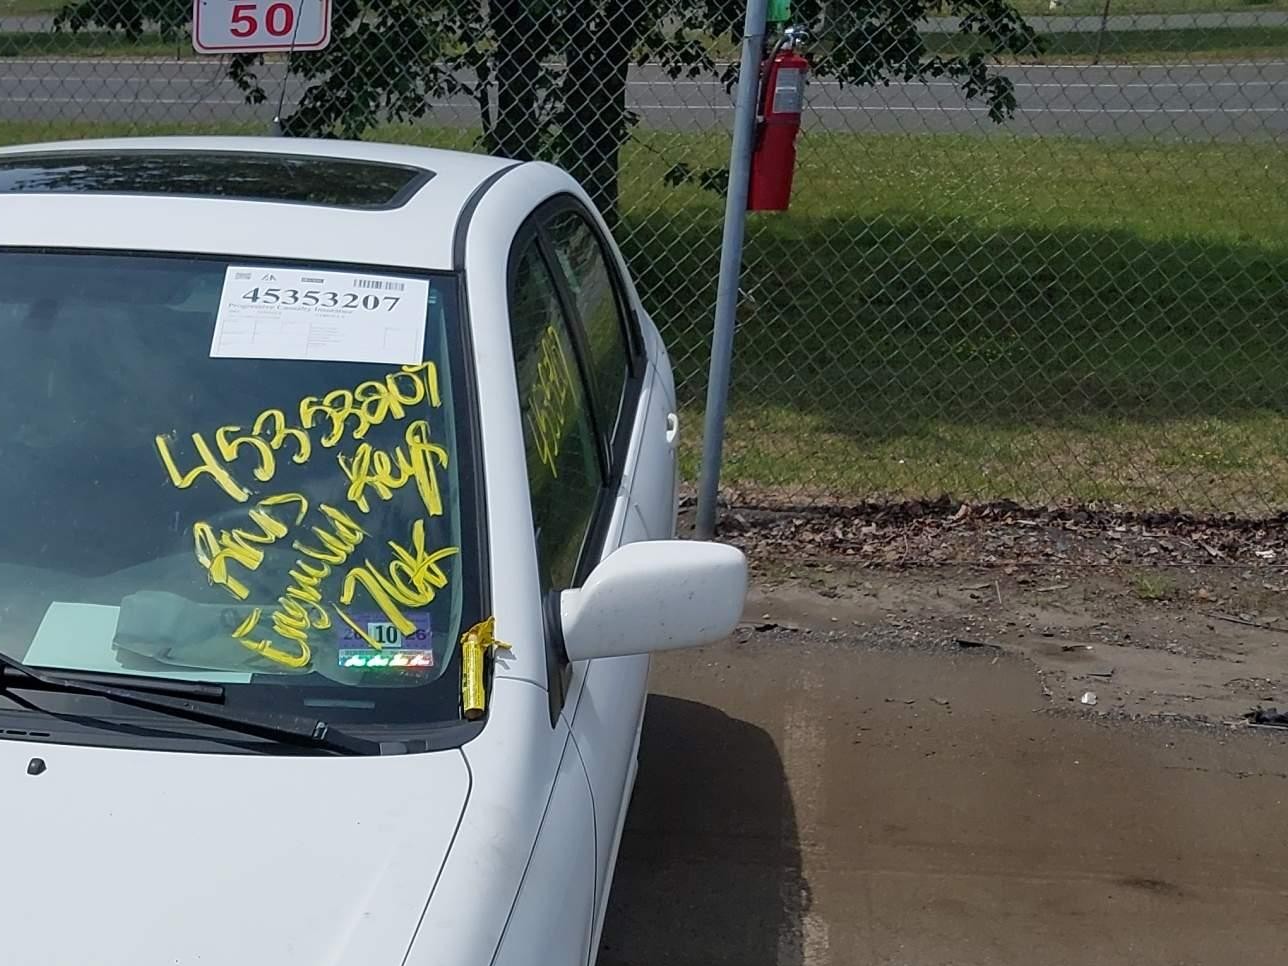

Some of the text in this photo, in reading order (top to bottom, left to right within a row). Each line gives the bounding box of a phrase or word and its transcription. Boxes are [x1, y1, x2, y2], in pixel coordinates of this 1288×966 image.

[230, 2, 295, 38] 50
[242, 287, 401, 312] 45353207
[154, 361, 442, 502] 45353207
[376, 625, 398, 643] 10
